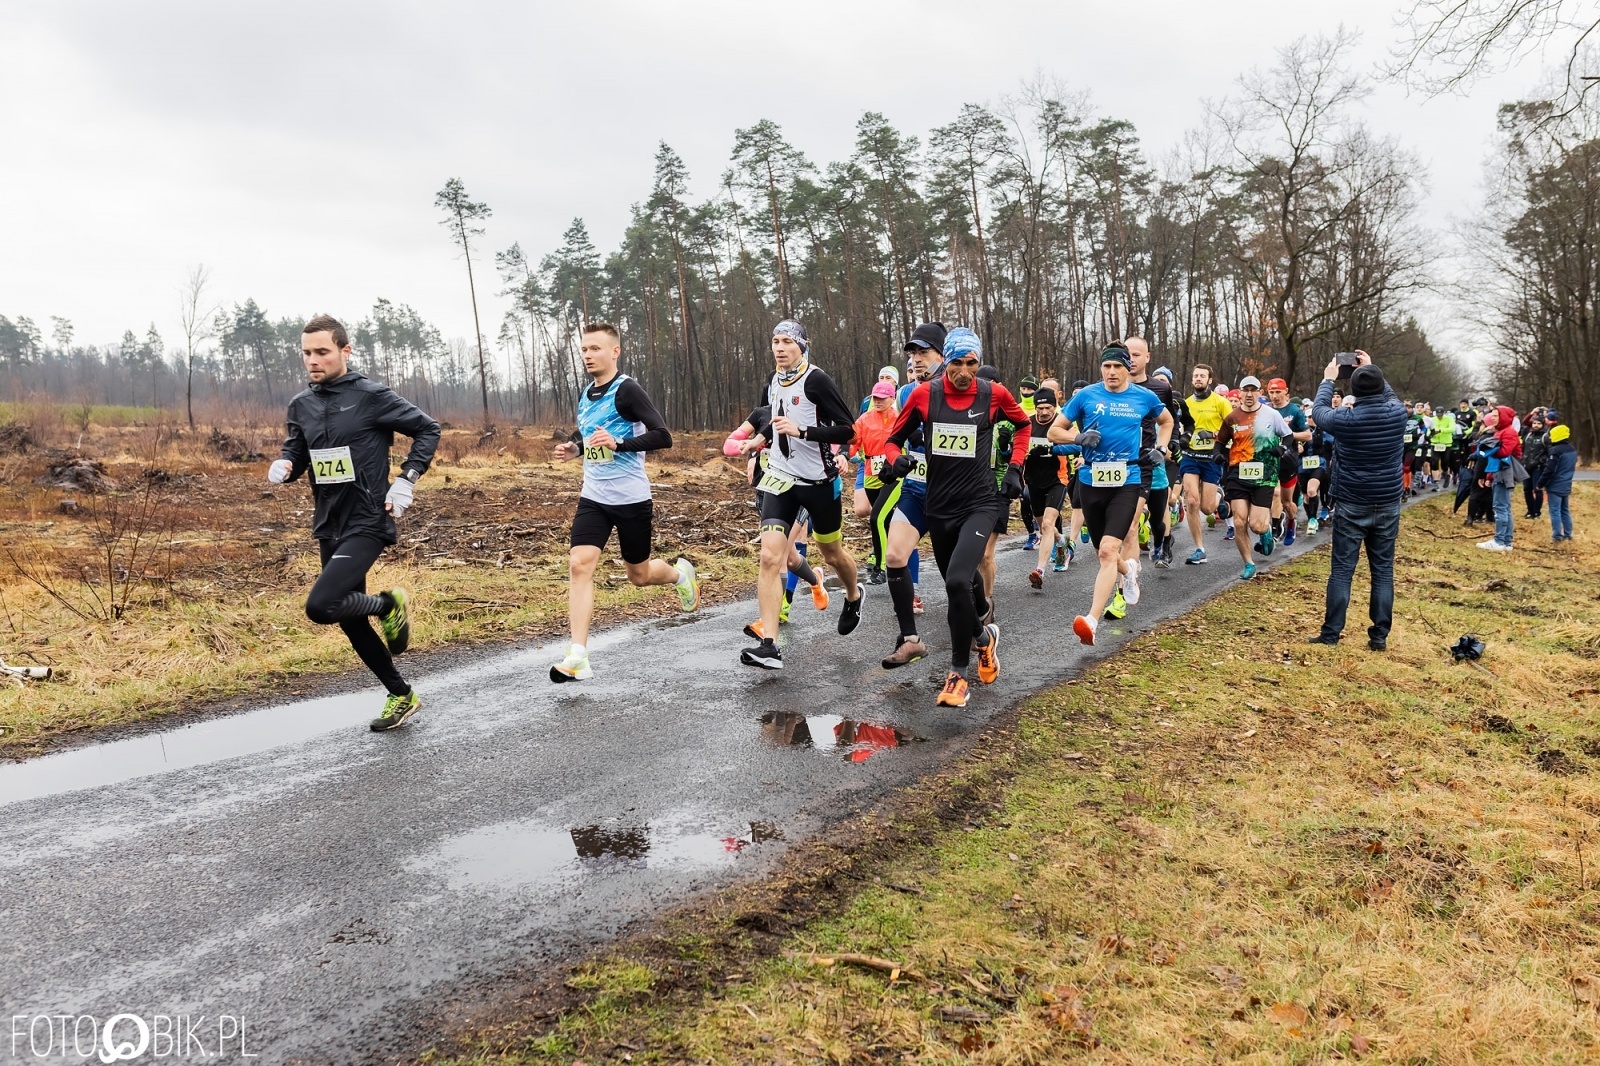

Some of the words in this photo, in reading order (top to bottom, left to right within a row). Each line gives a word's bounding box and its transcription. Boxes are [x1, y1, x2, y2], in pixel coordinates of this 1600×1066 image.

[938, 434, 969, 450] 273
[1196, 438, 1211, 446] 215
[585, 446, 606, 460] 261
[317, 459, 346, 476] 274
[873, 461, 884, 471] 23
[1243, 467, 1260, 476] 175
[1097, 469, 1122, 482] 218
[764, 475, 787, 491] 171
